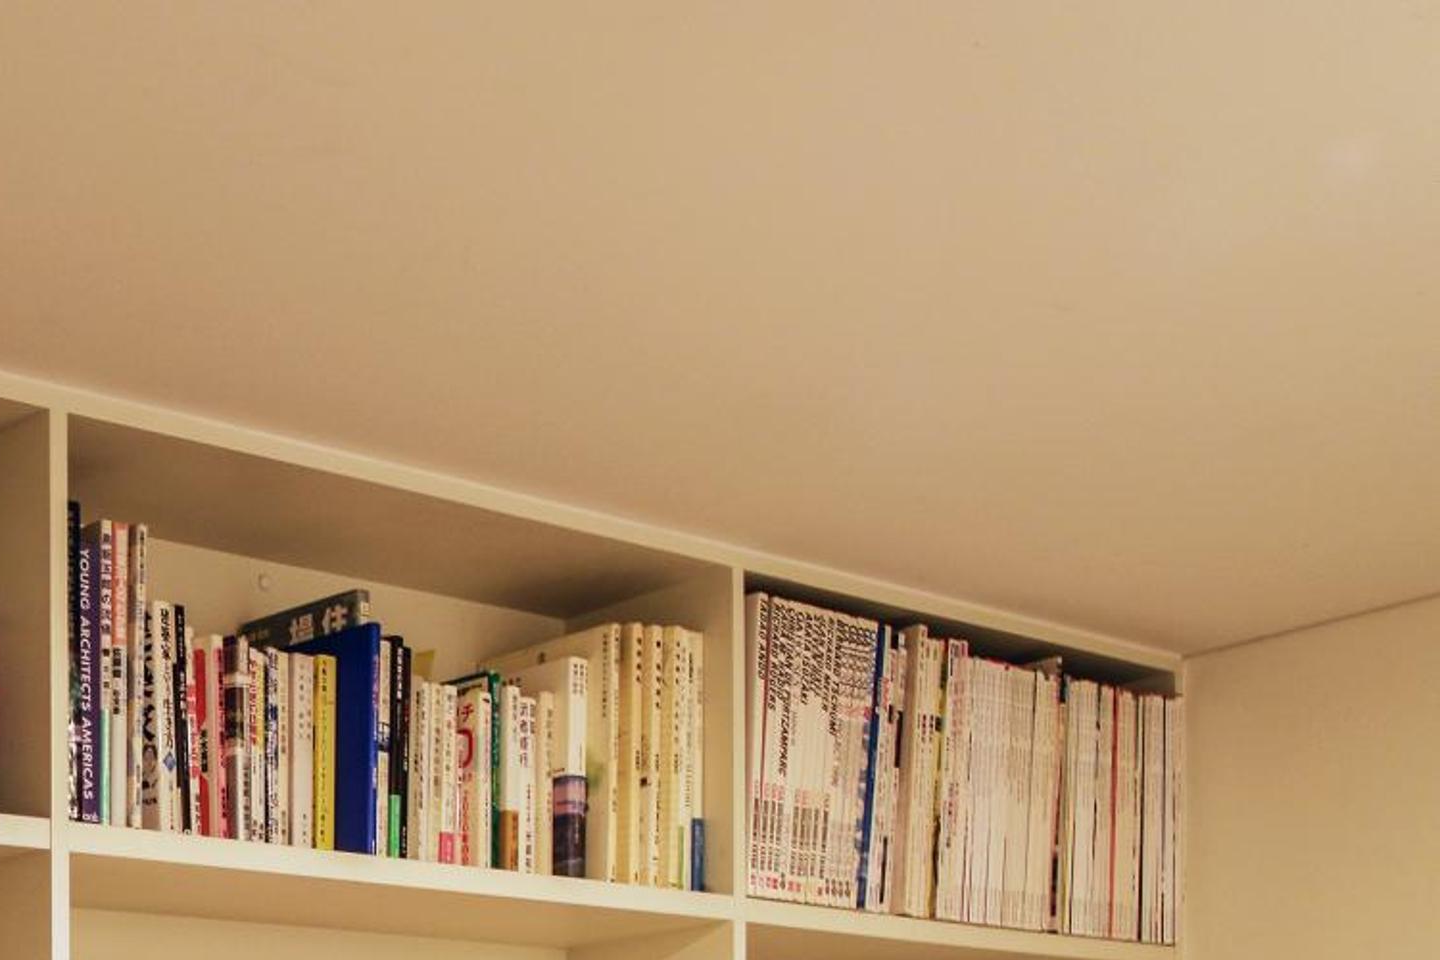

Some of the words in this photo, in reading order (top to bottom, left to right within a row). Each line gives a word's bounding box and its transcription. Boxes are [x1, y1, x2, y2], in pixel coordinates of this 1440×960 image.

[80, 549, 90, 610] YOUNG
[759, 598, 768, 641] TADAO
[771, 603, 781, 659] RICHARD
[80, 615, 92, 712] ARCHITECTS
[758, 643, 767, 680] ANDO
[768, 661, 779, 711] ROGERS
[82, 716, 94, 800] AMERICAS
